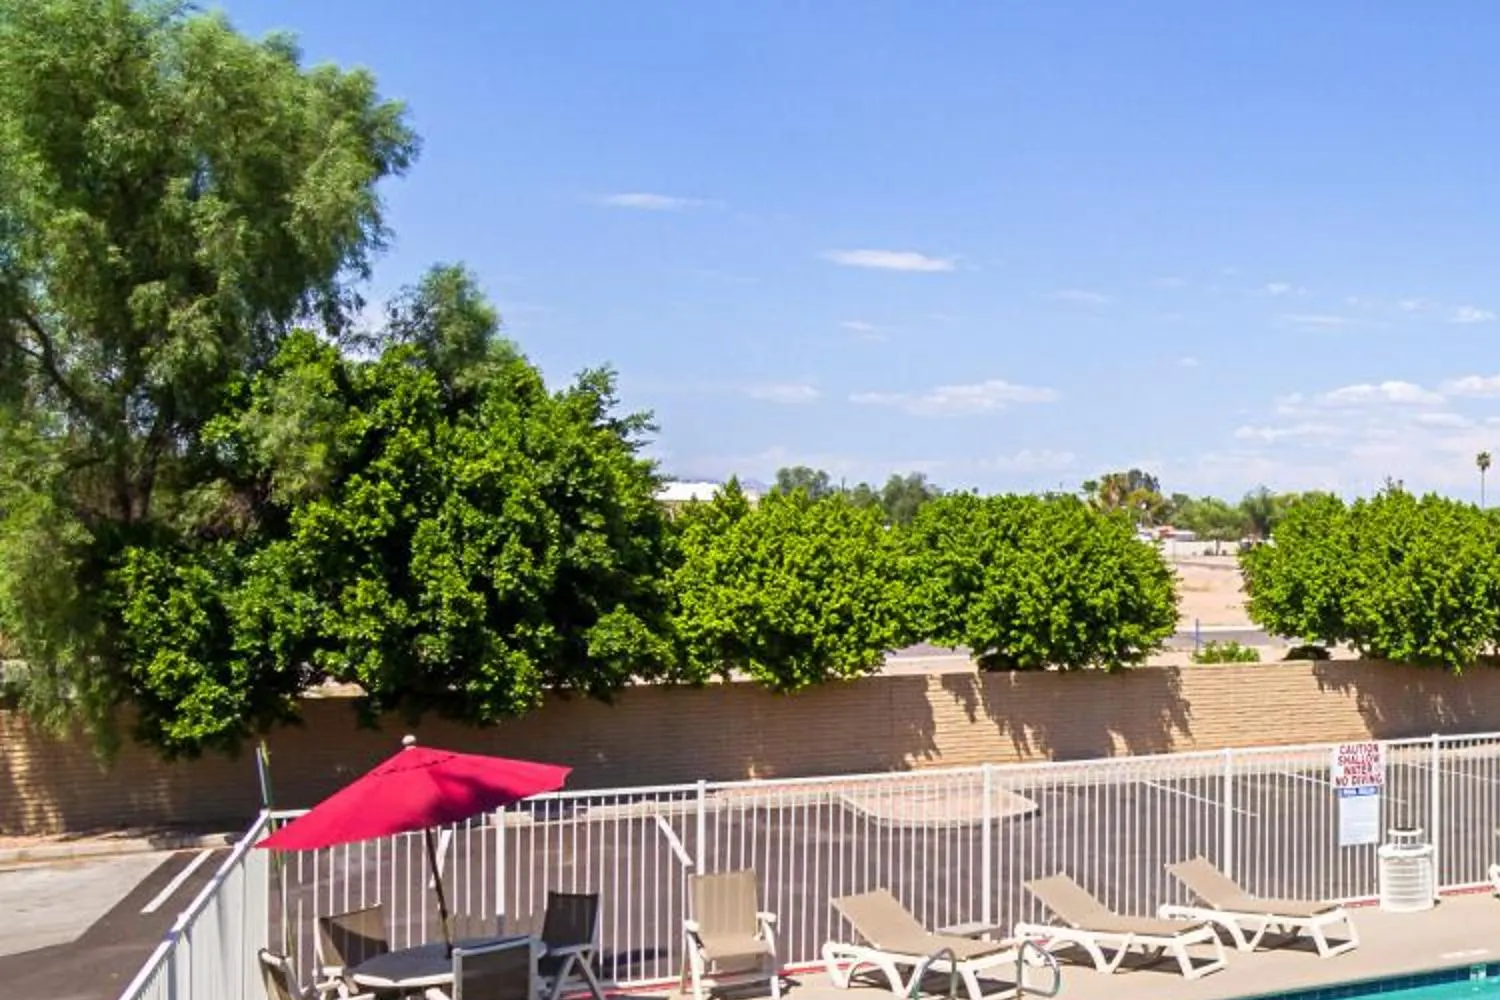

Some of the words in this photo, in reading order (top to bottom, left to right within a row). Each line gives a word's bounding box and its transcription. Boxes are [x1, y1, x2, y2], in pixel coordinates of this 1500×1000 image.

[1340, 744, 1379, 754] CAUTION
[1338, 754, 1379, 766] SHALLOW
[1335, 776, 1349, 786] NO
[1351, 772, 1382, 785] DIVING
